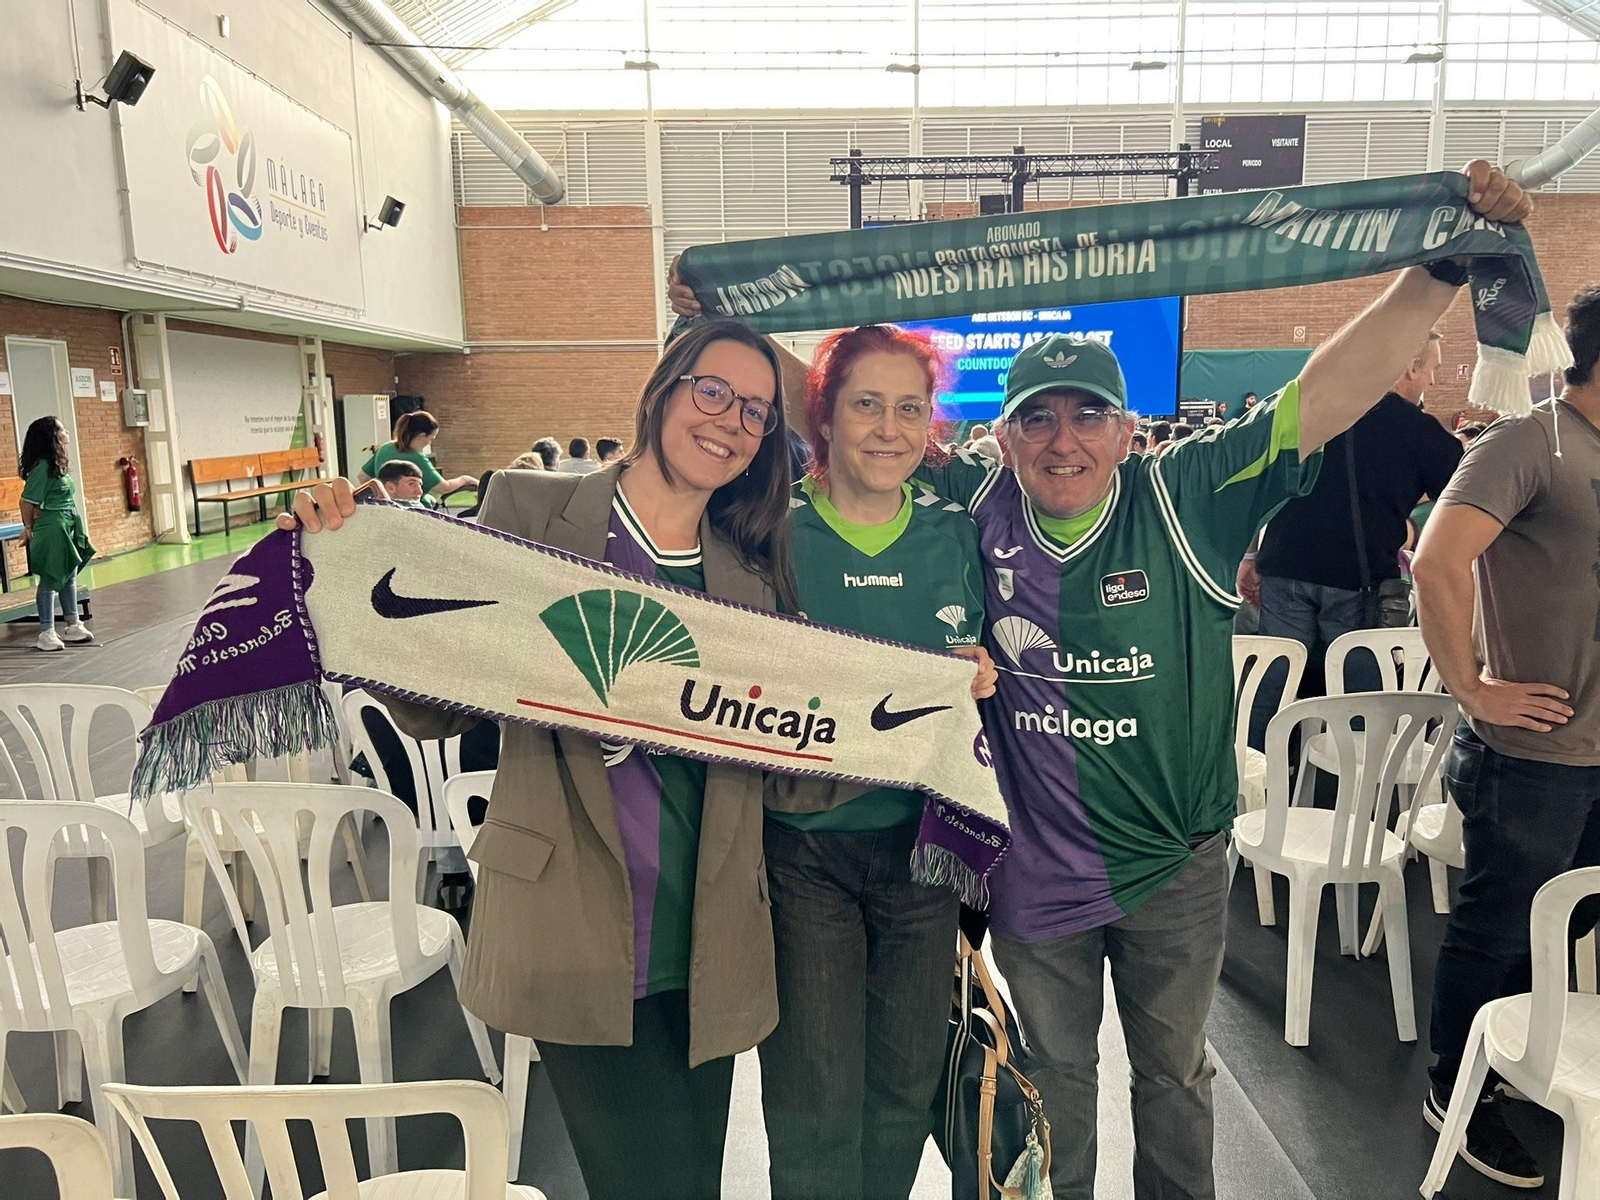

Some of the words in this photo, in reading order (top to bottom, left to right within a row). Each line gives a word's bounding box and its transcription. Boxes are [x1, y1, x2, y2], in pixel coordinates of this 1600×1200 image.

[1205, 139, 1232, 148] LOCAL
[1272, 138, 1299, 147] VISITANTE
[267, 157, 325, 211] MÁLAGA
[270, 200, 297, 231] Deporte
[298, 217, 304, 239] y
[304, 214, 328, 241] Eventos
[986, 221, 1041, 243] ABONADO
[1241, 191, 1400, 252] MARTIN
[935, 236, 1062, 266] PROTAGONISTA
[1077, 231, 1099, 249] DE
[893, 258, 1015, 299] NUESTRA
[1023, 239, 1156, 285] HISTORIA
[715, 264, 812, 317] JARDIN
[965, 331, 1020, 350] STARTS
[843, 572, 903, 587] hummel
[1105, 583, 1125, 593] liga
[1107, 589, 1146, 601] endesa
[945, 635, 977, 645] Unicaja
[1052, 646, 1154, 676] Unicaja
[679, 679, 836, 750] Unicaja
